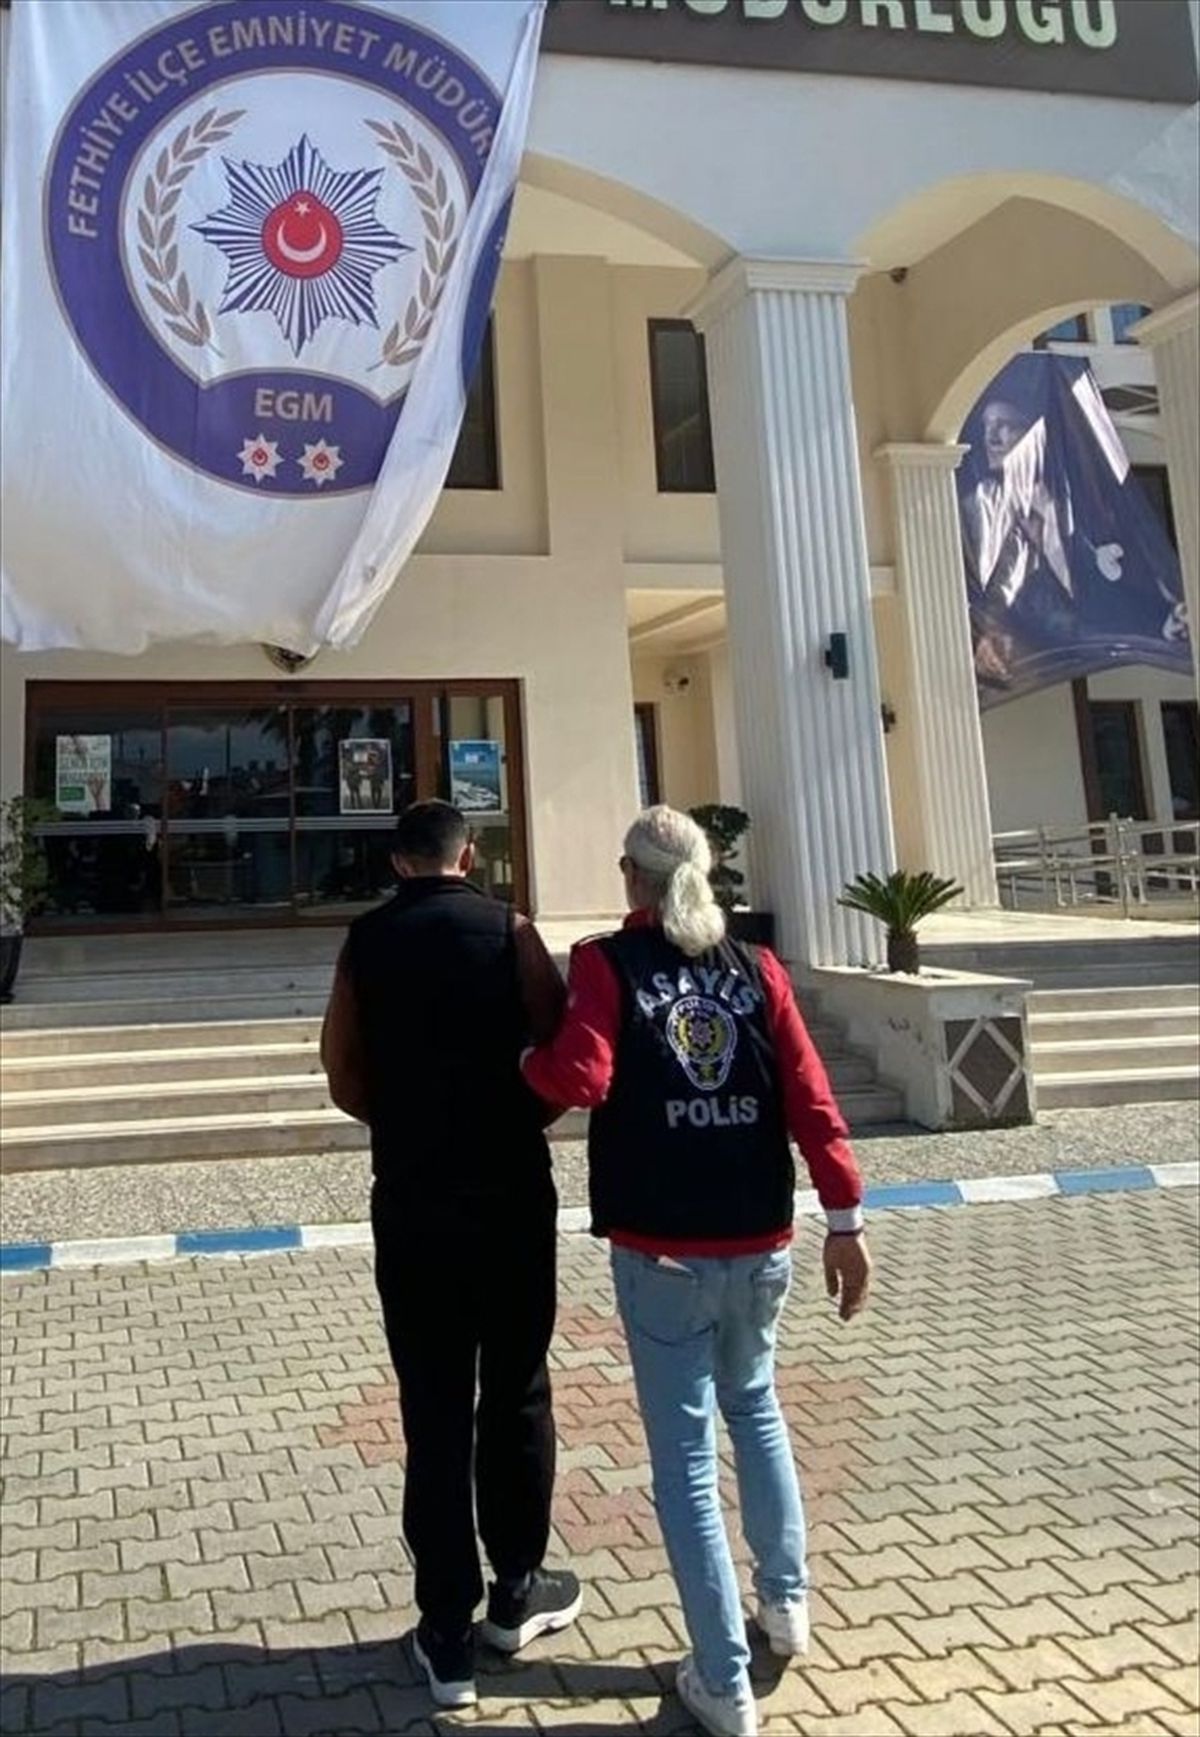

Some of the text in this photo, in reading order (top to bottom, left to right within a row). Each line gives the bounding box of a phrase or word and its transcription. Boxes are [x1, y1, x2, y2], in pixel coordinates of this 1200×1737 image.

[67, 92, 140, 239] FETHİYE
[123, 38, 206, 103] İLÇE
[207, 10, 381, 60] EMNİYET
[254, 387, 334, 423] EGM
